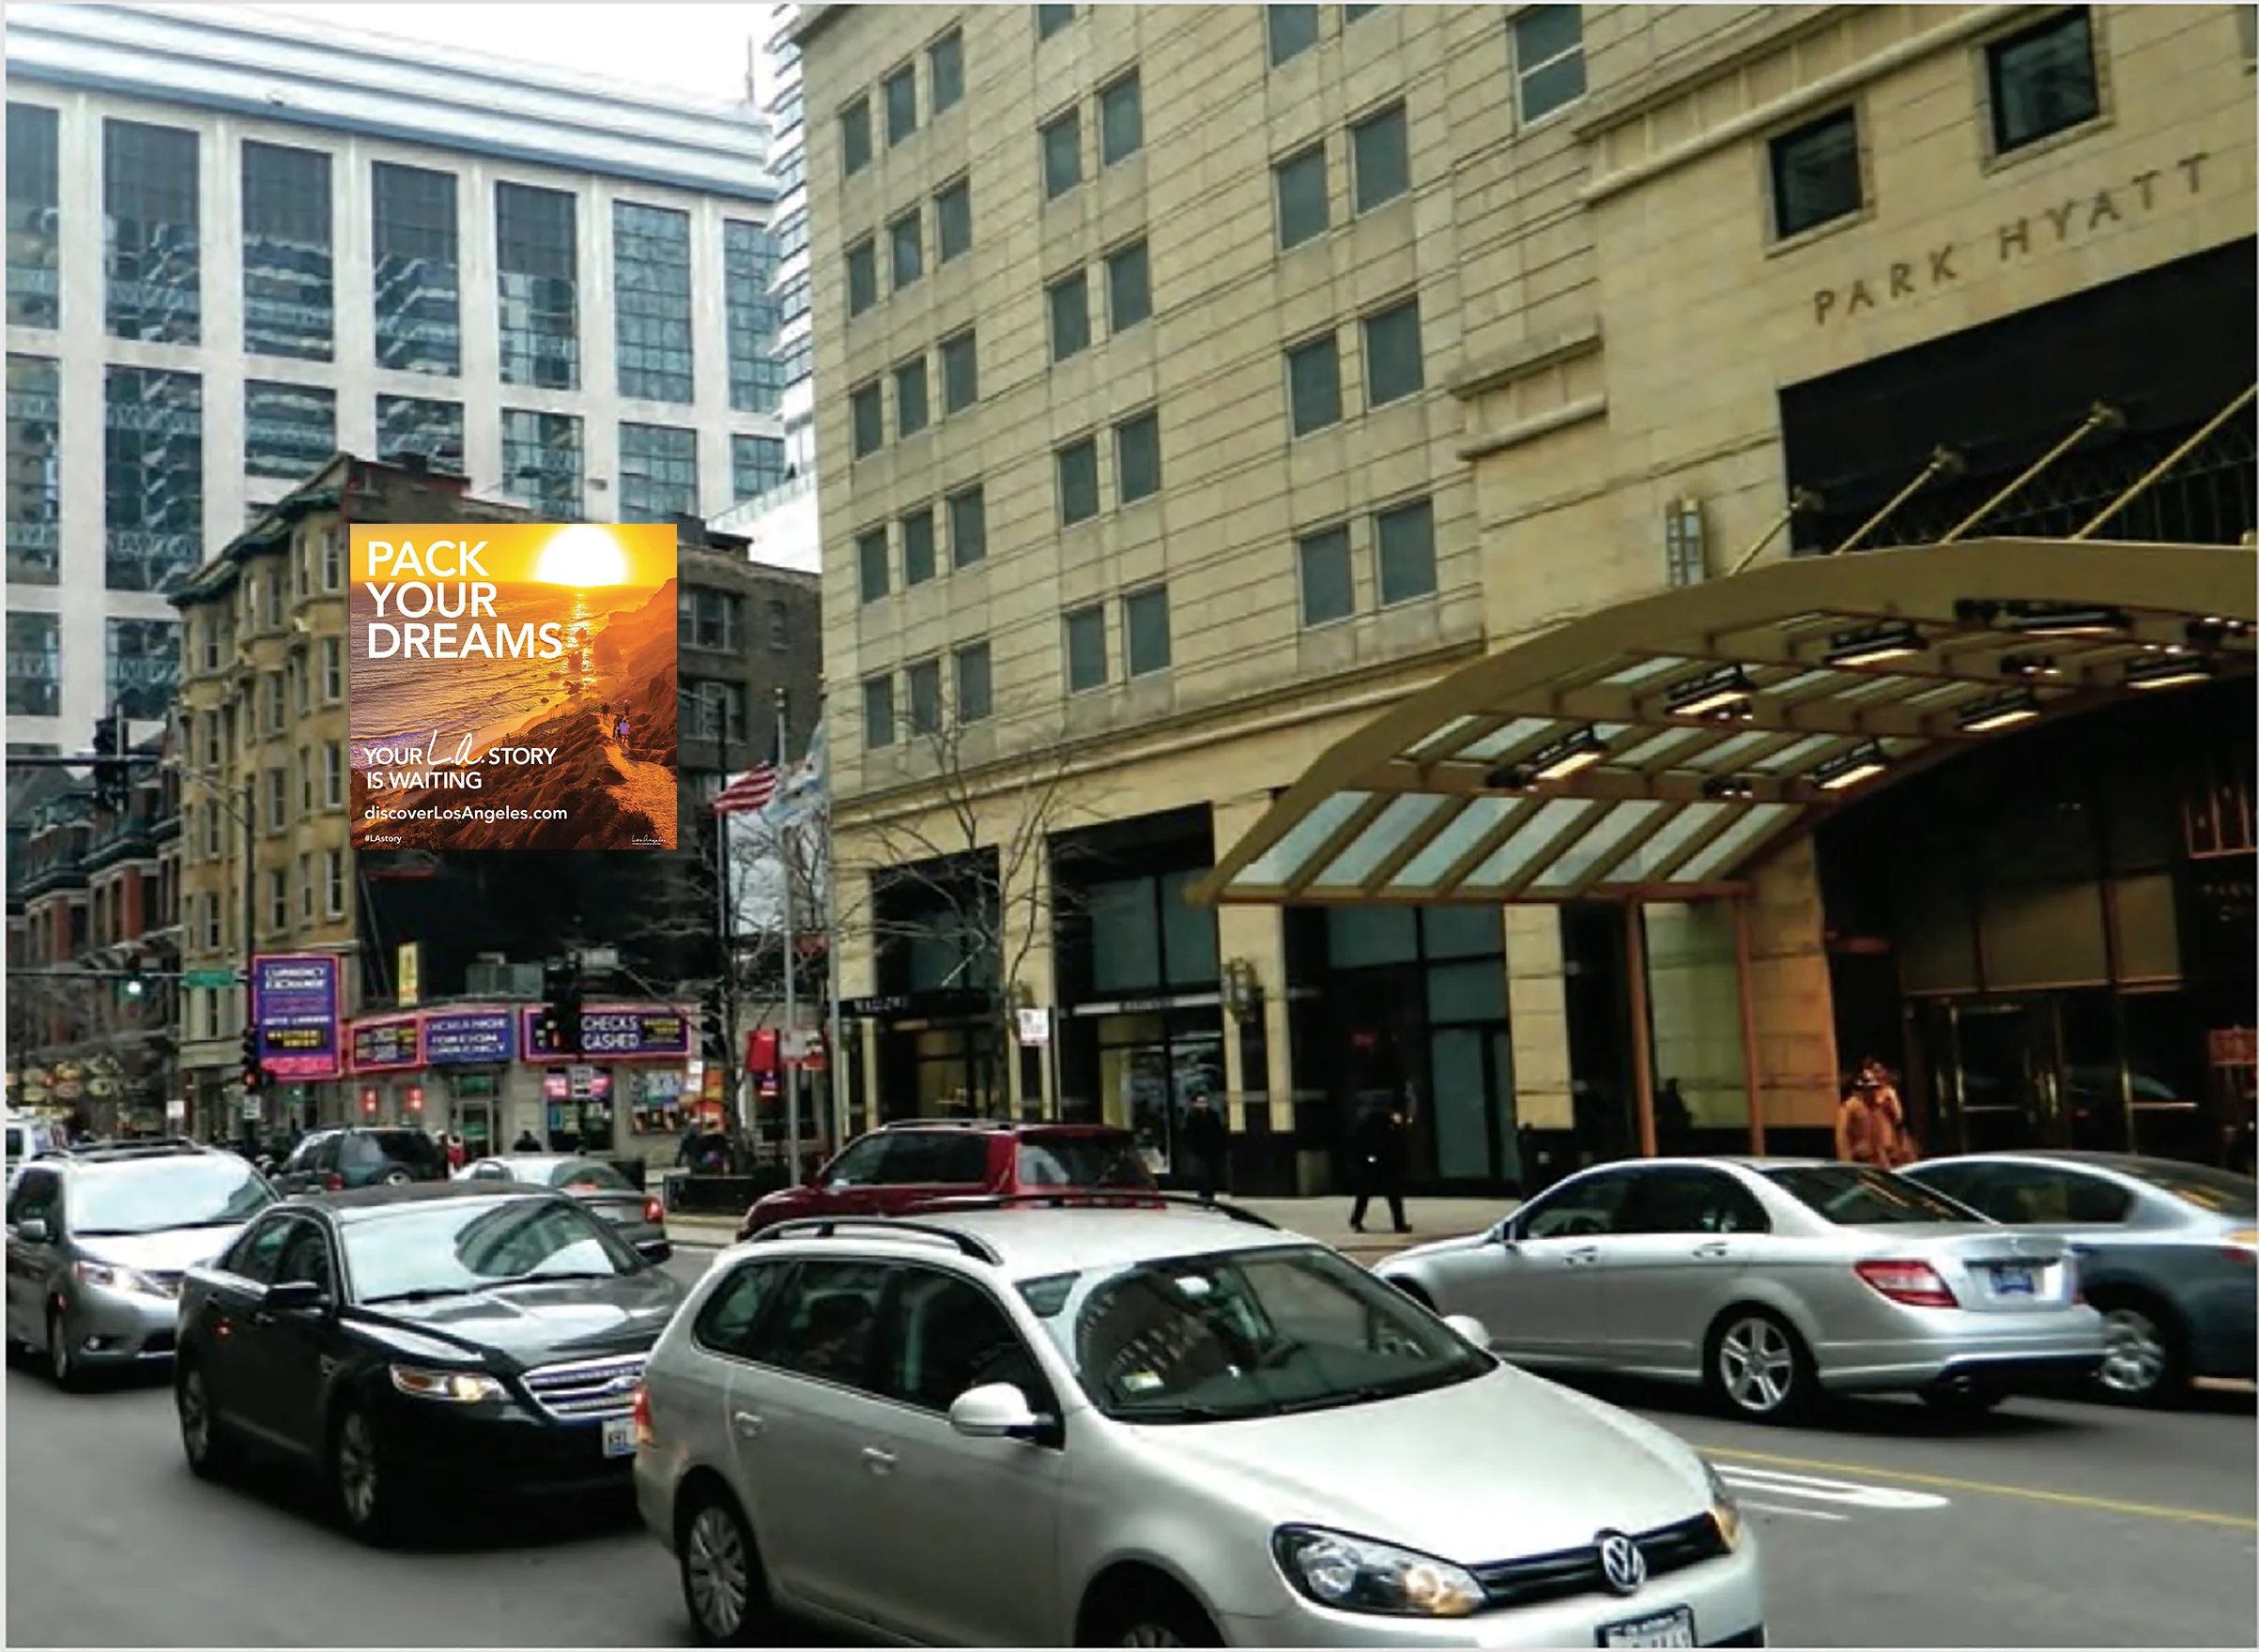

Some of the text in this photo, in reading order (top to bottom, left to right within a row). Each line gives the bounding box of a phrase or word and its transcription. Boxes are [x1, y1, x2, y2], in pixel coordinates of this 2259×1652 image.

[1813, 152, 2210, 325] PARK HYATT
[367, 540, 490, 577] PACK
[364, 581, 498, 619] YOUR
[367, 622, 563, 660] DREAMS
[363, 747, 423, 765] YOUR
[488, 747, 558, 765] STORY
[367, 772, 483, 789] IS WAITING
[364, 805, 568, 824] discoverLosAngeles.com
[364, 834, 403, 844] #LAstory
[580, 1015, 638, 1032] CHECKS
[580, 1033, 639, 1050] CASHED
